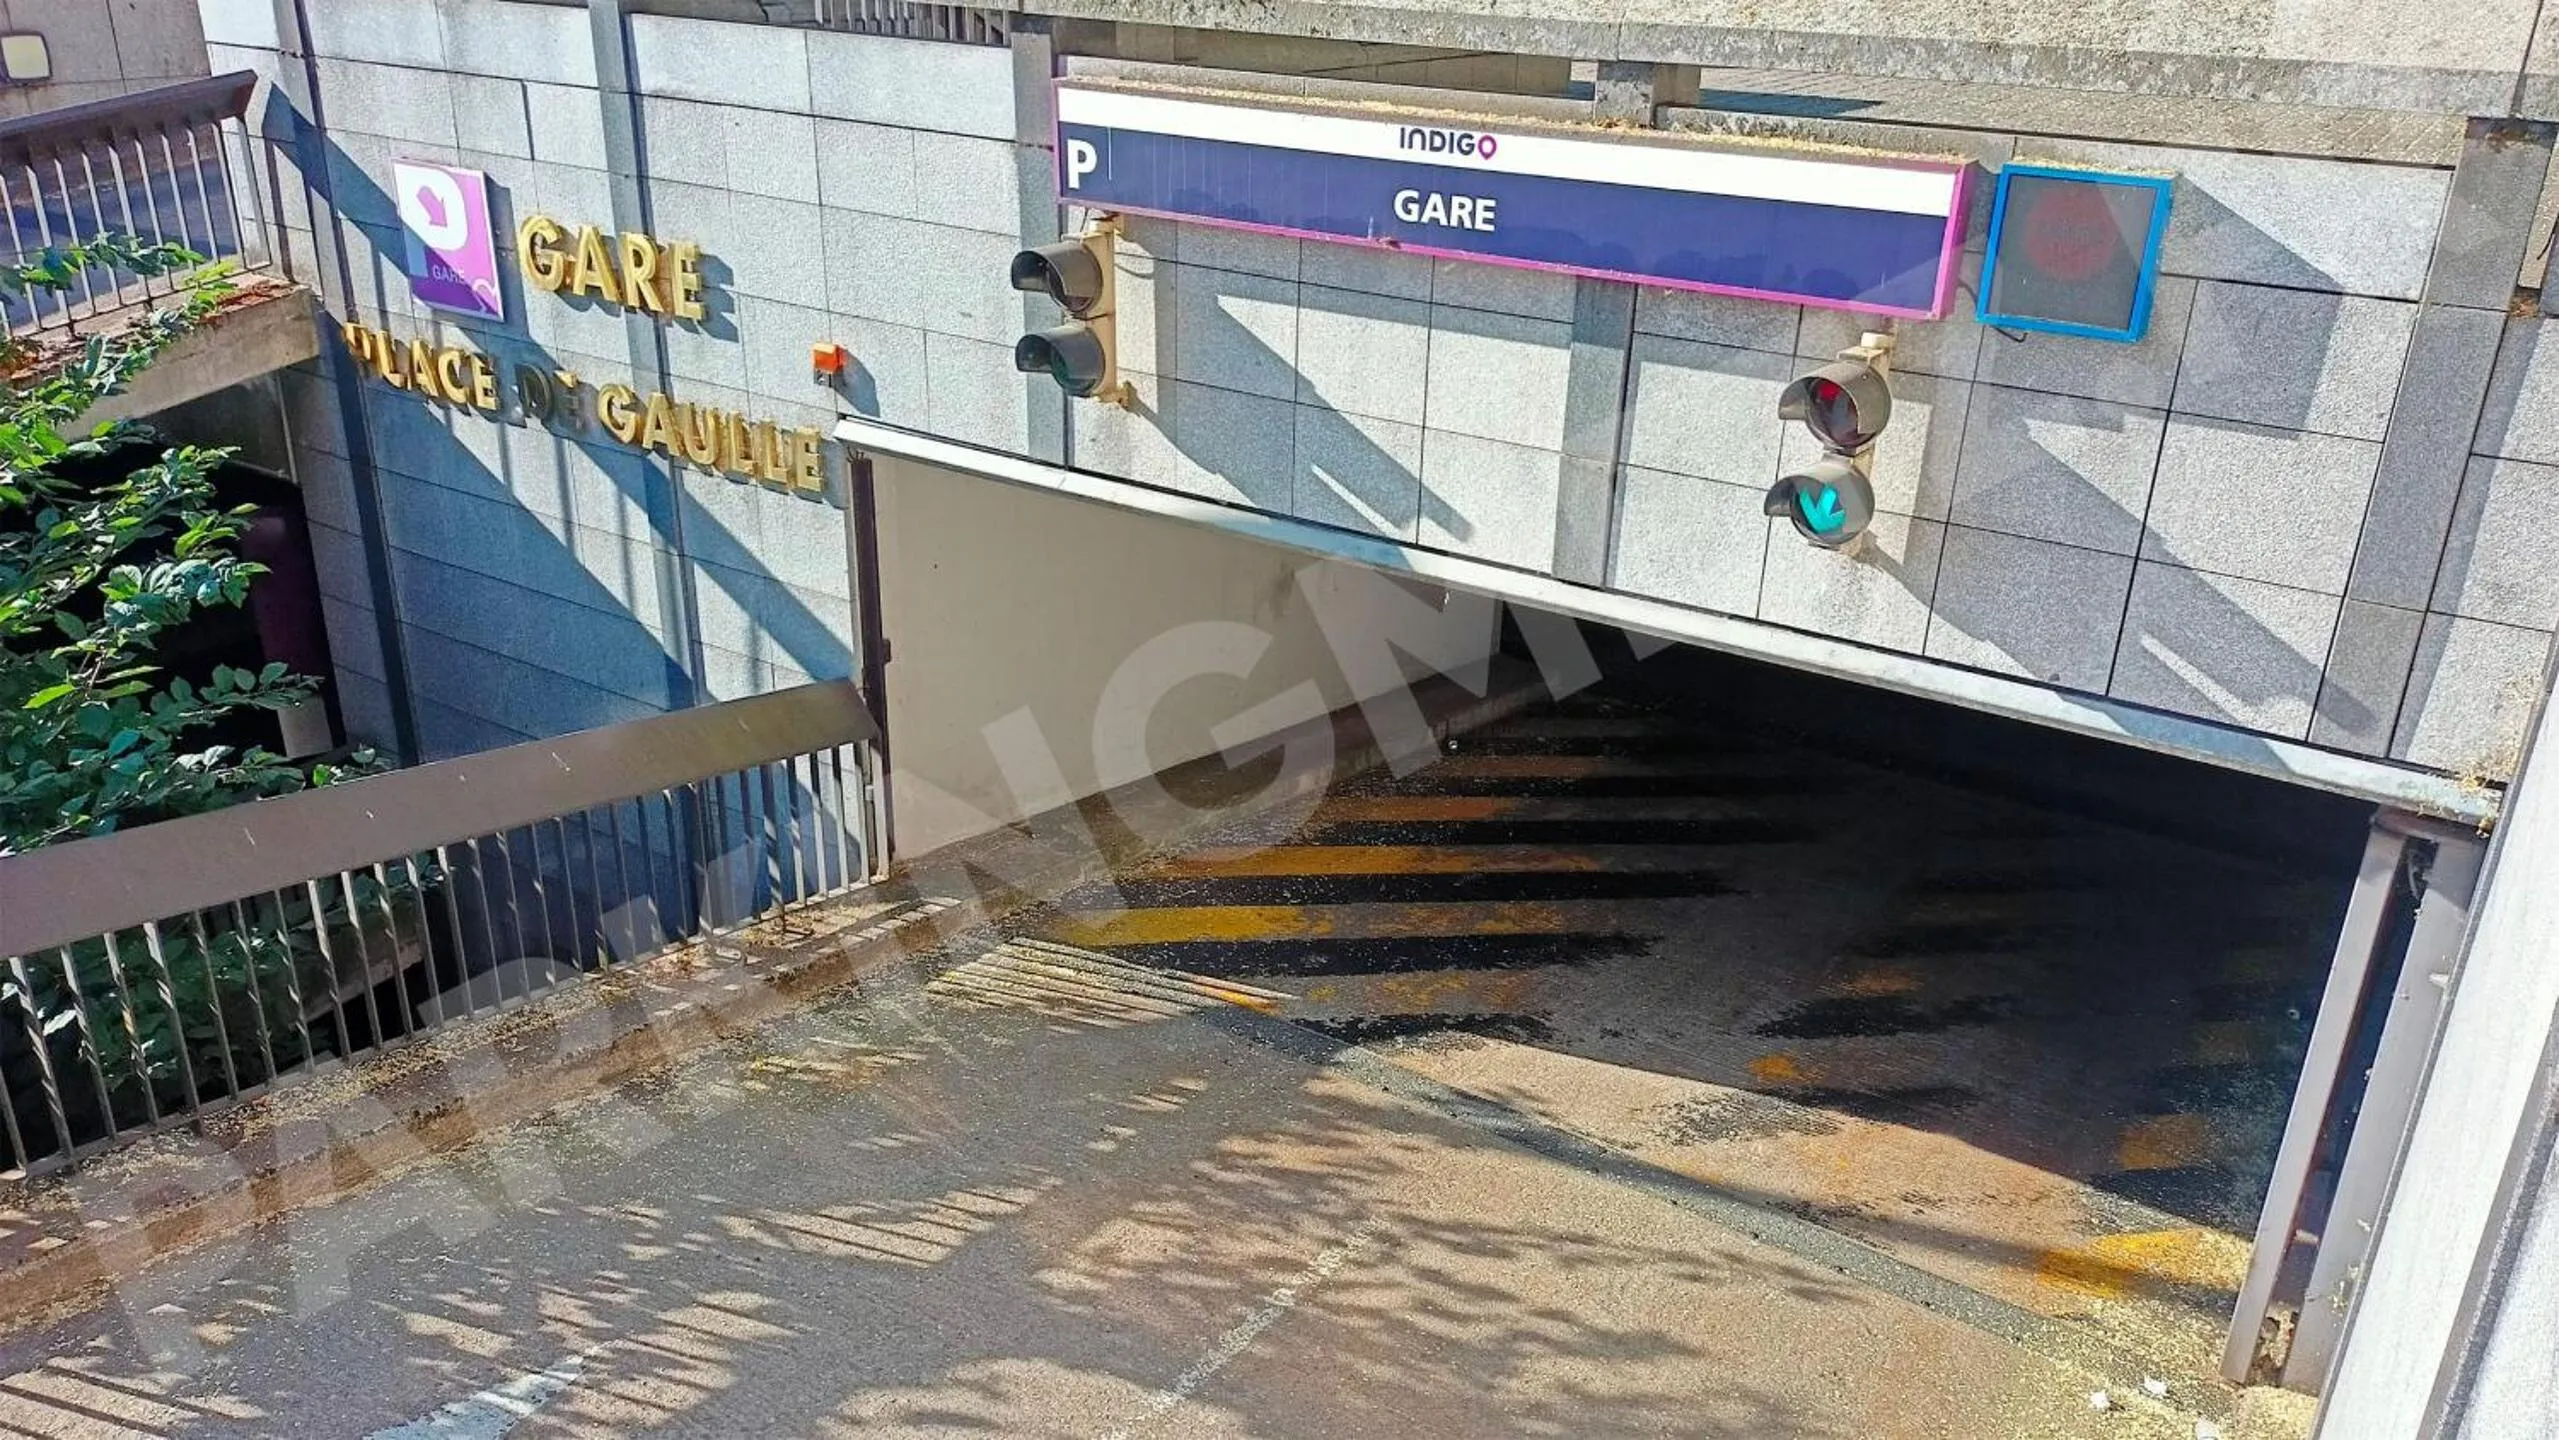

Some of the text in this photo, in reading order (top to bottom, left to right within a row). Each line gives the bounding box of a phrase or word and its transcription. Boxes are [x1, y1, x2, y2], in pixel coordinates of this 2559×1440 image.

[1067, 138, 1098, 189] P
[1400, 127, 1497, 160] INDIGO
[1393, 188, 1497, 232] GARE
[432, 265, 465, 283] GARE
[518, 214, 705, 321] GARE
[598, 383, 822, 493] GAULLE
